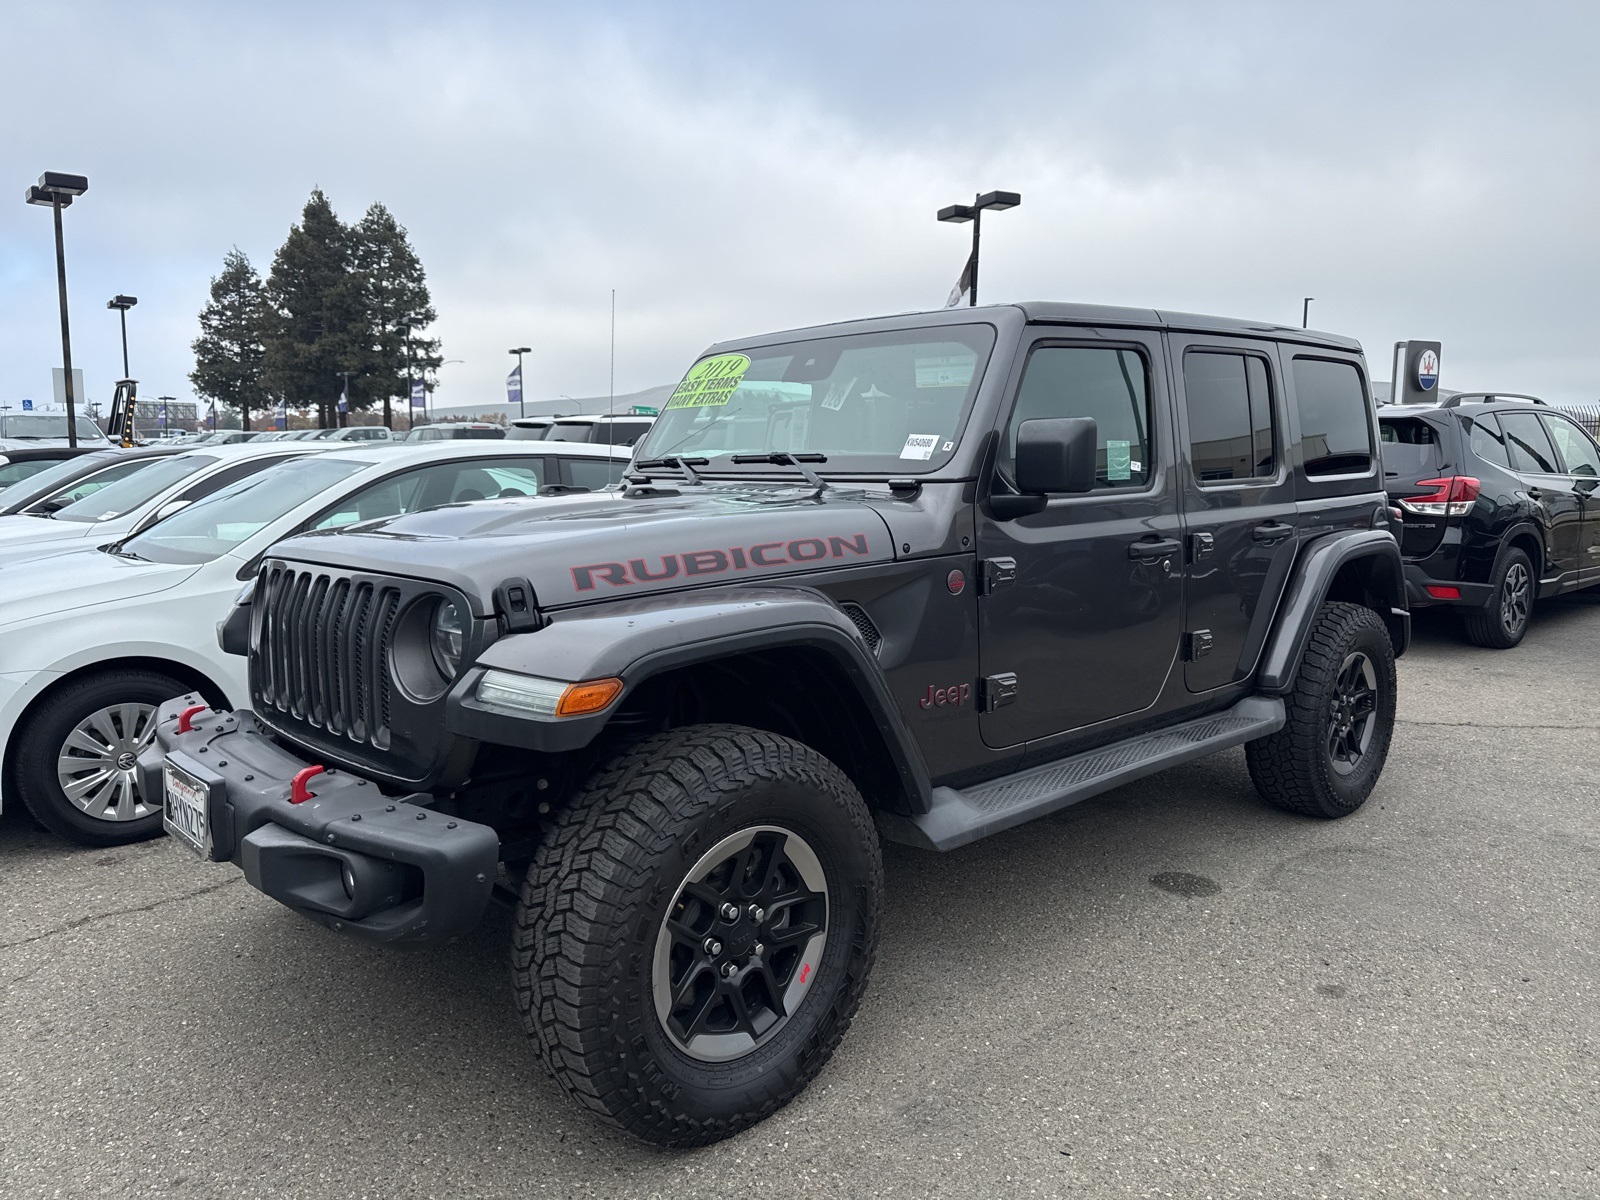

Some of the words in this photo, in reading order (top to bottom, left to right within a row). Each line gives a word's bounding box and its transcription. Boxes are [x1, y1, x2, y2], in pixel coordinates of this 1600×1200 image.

[695, 358, 744, 380] 2019
[676, 379, 704, 394] EASY
[702, 375, 742, 390] TERMS
[668, 393, 696, 407] MANY
[692, 390, 733, 405] EXTRAS
[944, 442, 951, 450] X
[569, 533, 870, 592] RUBICON
[919, 682, 972, 710] Jeep
